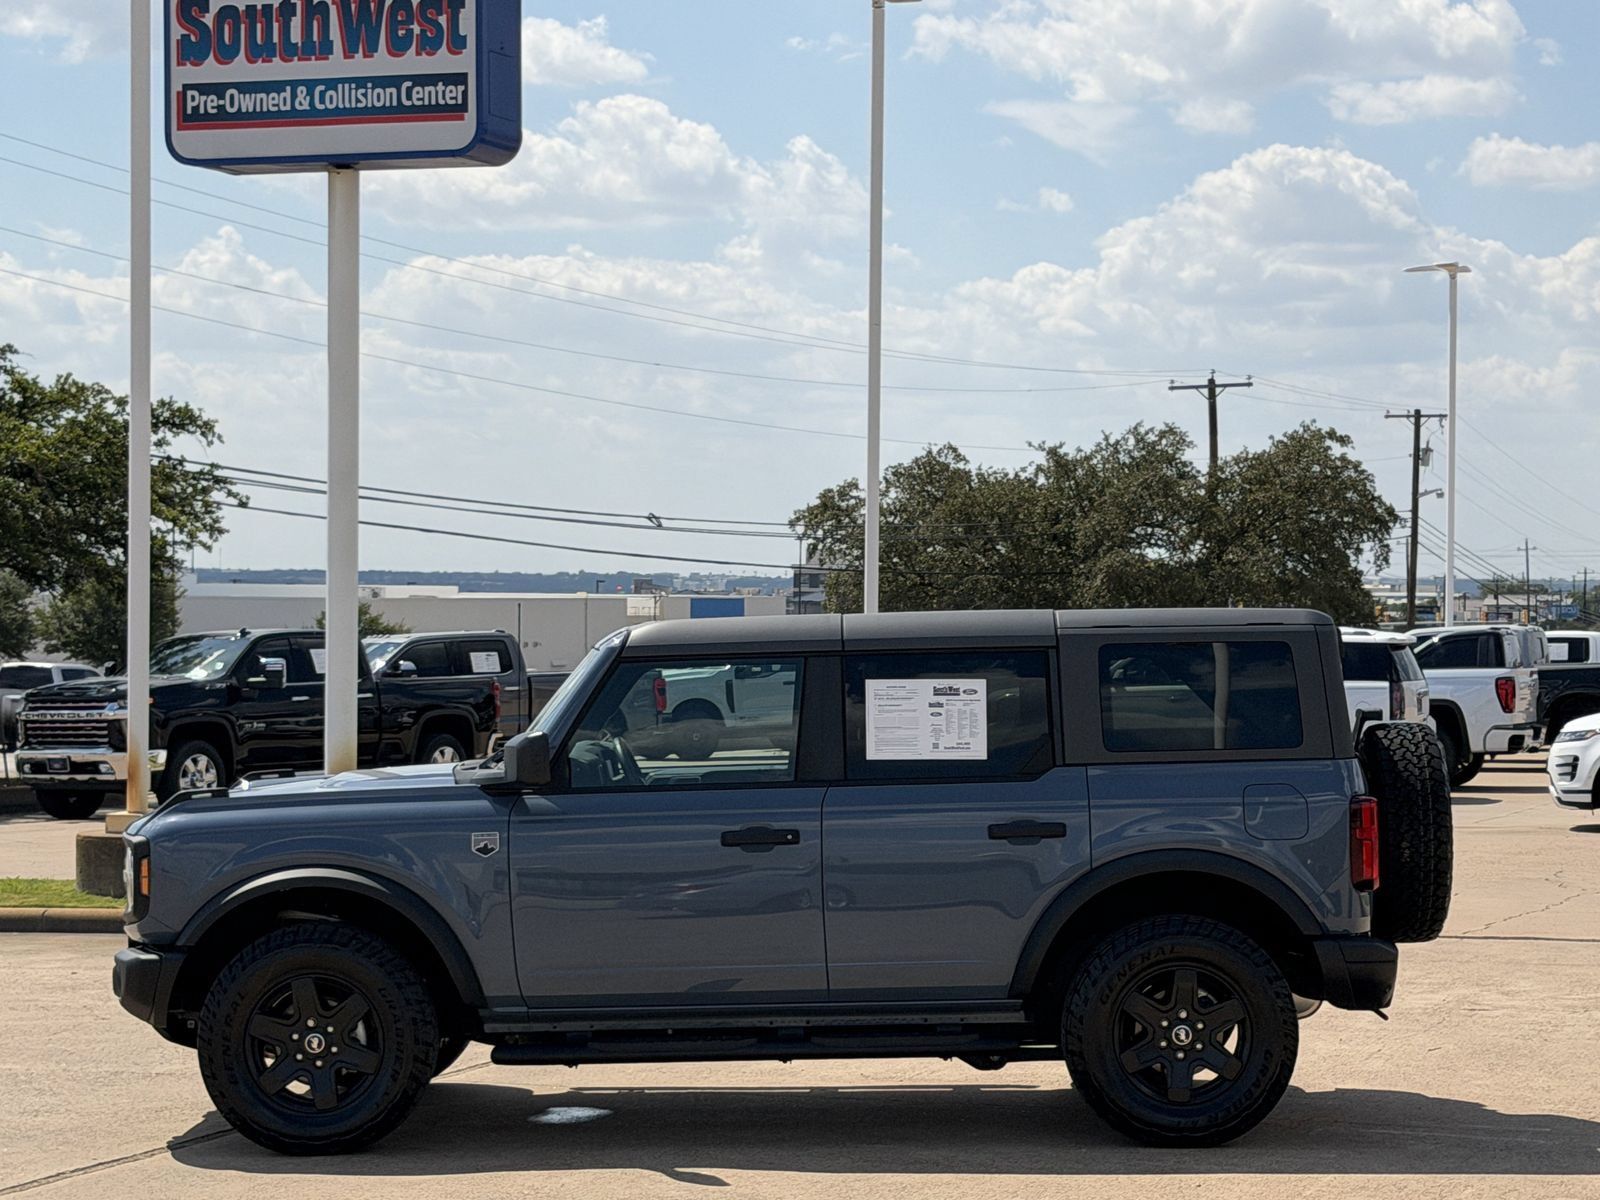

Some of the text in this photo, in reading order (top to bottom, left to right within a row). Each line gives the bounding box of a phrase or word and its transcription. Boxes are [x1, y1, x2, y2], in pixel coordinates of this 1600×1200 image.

[186, 81, 465, 116] Pre-Owned & Collision Center
[24, 711, 105, 720] CHEVROLET
[1101, 945, 1183, 1005] GENERAL
[223, 992, 246, 1085] GENERAL
